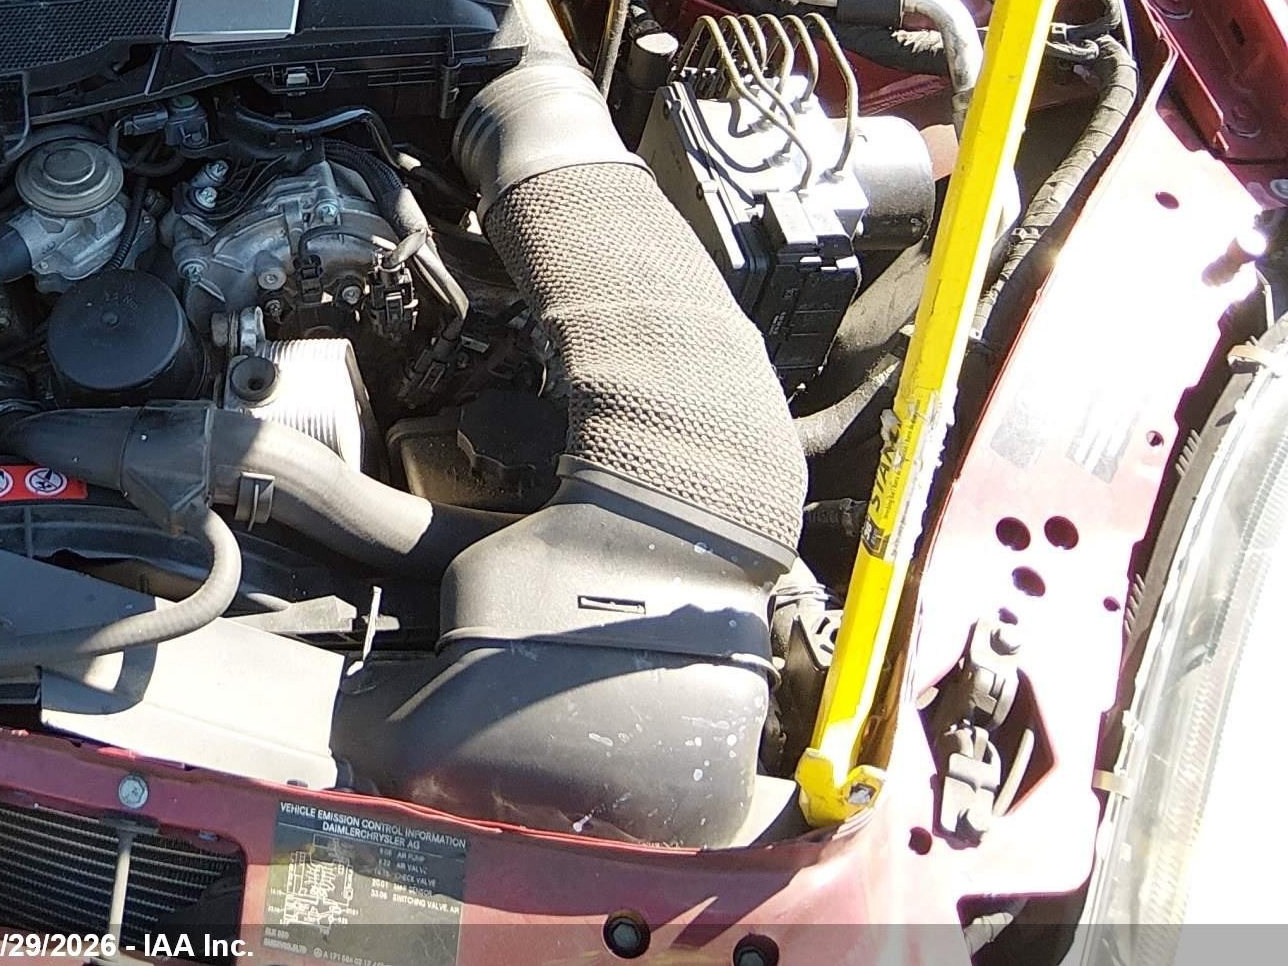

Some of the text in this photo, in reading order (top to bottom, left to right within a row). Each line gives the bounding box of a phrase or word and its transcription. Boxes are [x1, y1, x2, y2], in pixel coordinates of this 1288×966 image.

[280, 801, 466, 851] VEHICLE EMISSION CONTROL INFORMATION
[322, 821, 420, 850] DAIMLERCHRYSLER AG
